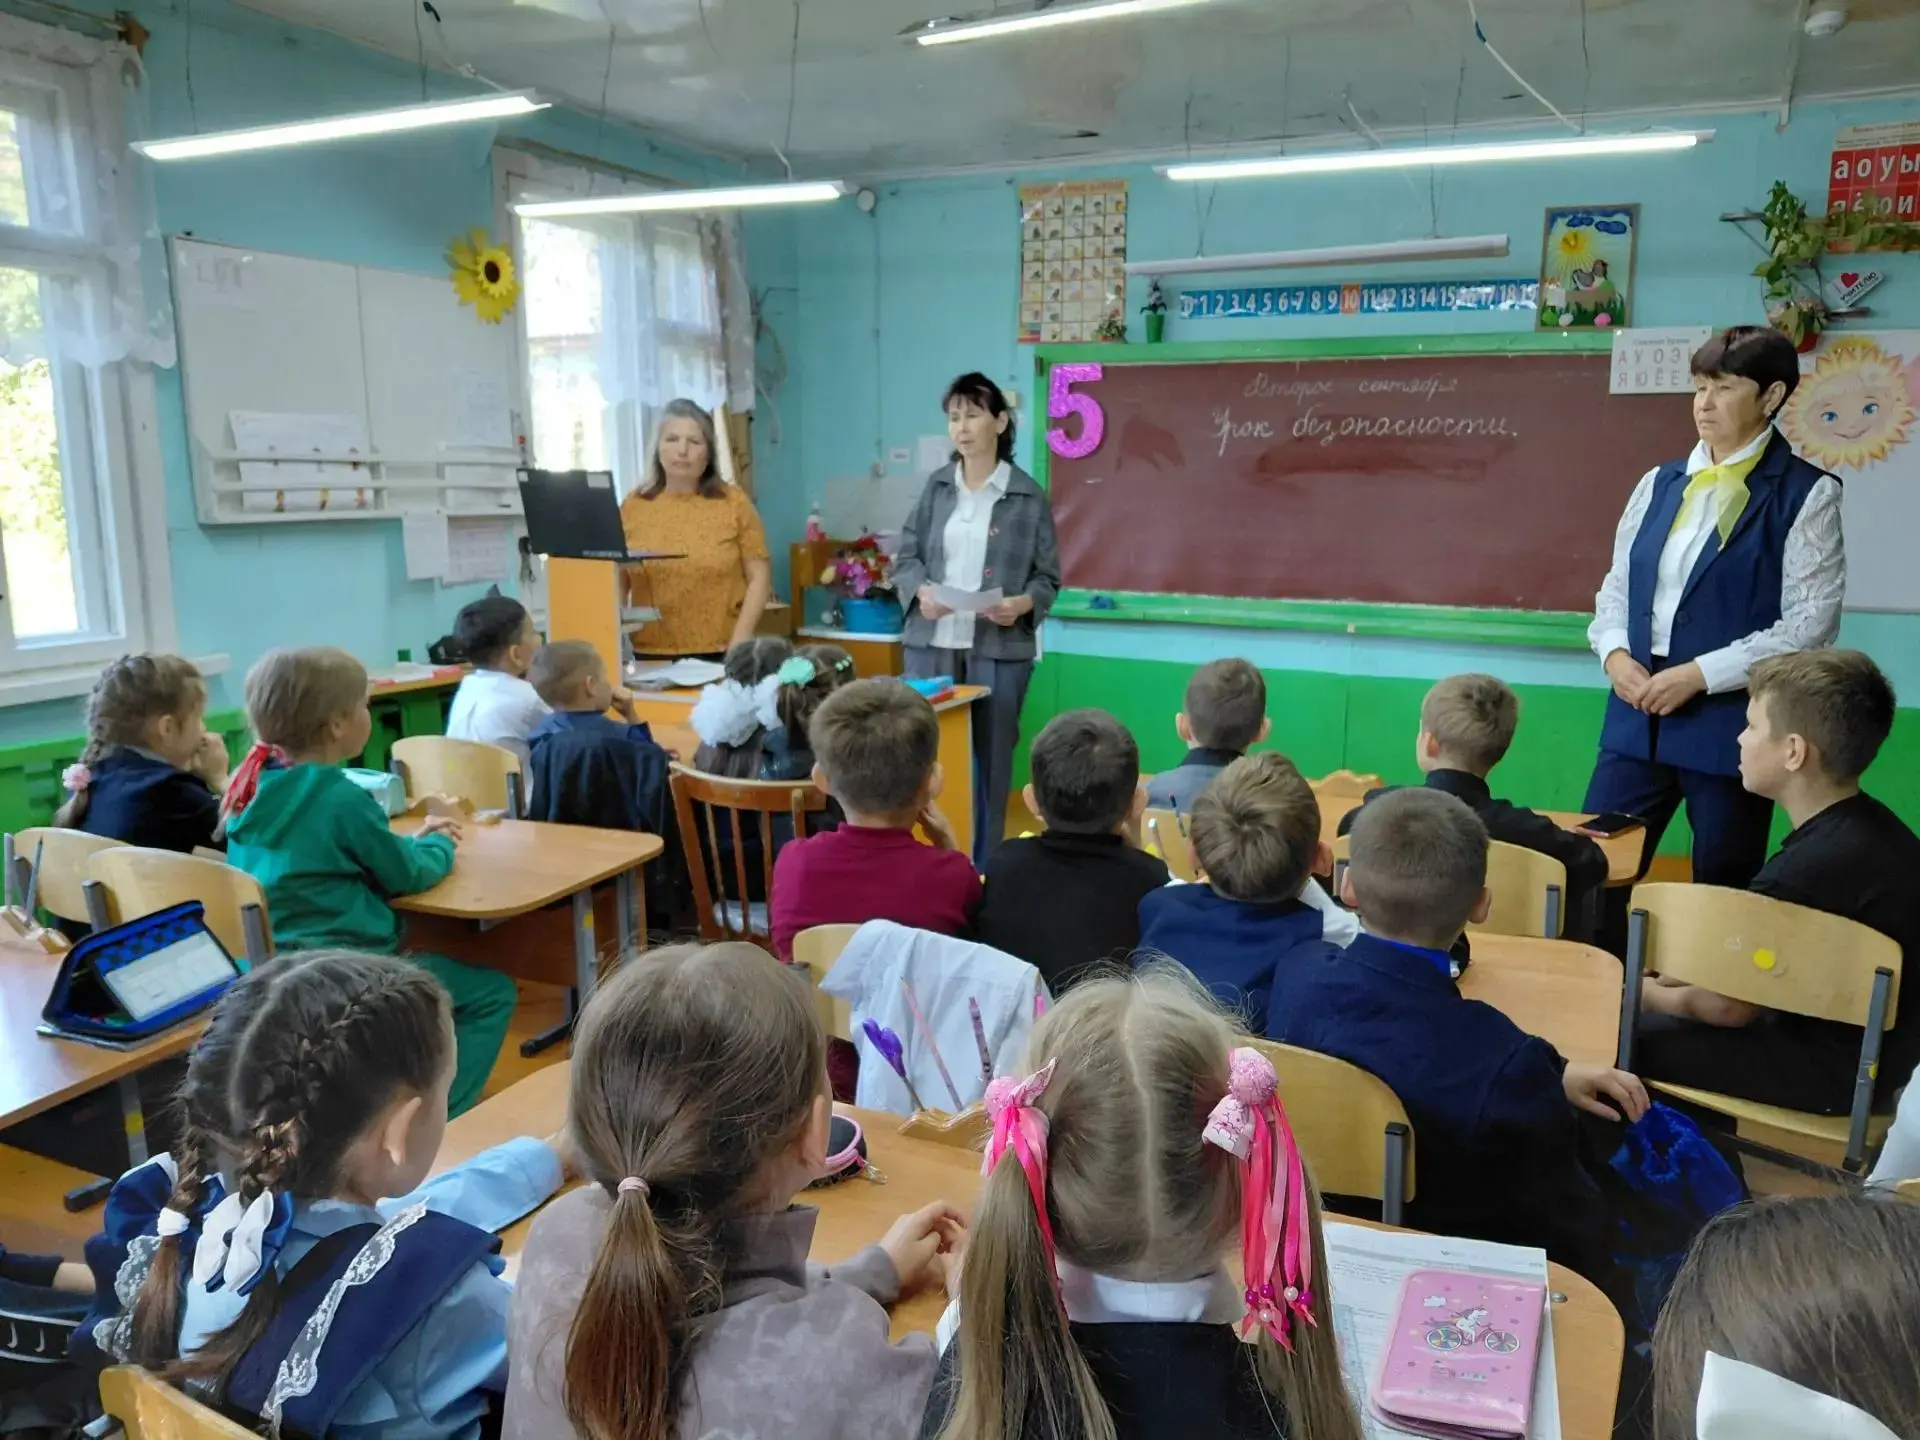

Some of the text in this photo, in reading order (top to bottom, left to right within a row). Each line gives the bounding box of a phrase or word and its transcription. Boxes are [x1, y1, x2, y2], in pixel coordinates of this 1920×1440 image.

[1834, 159, 1849, 179] а
[1857, 158, 1872, 177] о
[1879, 155, 1896, 182] у
[1897, 195, 1914, 214] и
[1213, 294, 1225, 314] 2
[1231, 293, 1240, 311] 3
[1246, 293, 1256, 312] 4
[1262, 292, 1272, 312] 5
[1278, 292, 1288, 312] 6
[1310, 290, 1321, 311] 8
[1327, 290, 1338, 310] 9
[1343, 289, 1358, 309] 10
[1400, 287, 1416, 308] 13
[1420, 286, 1437, 307] 14
[1440, 286, 1456, 306] 15
[1047, 362, 1104, 459] 5
[1210, 403, 1519, 457] Урок безопасности.
